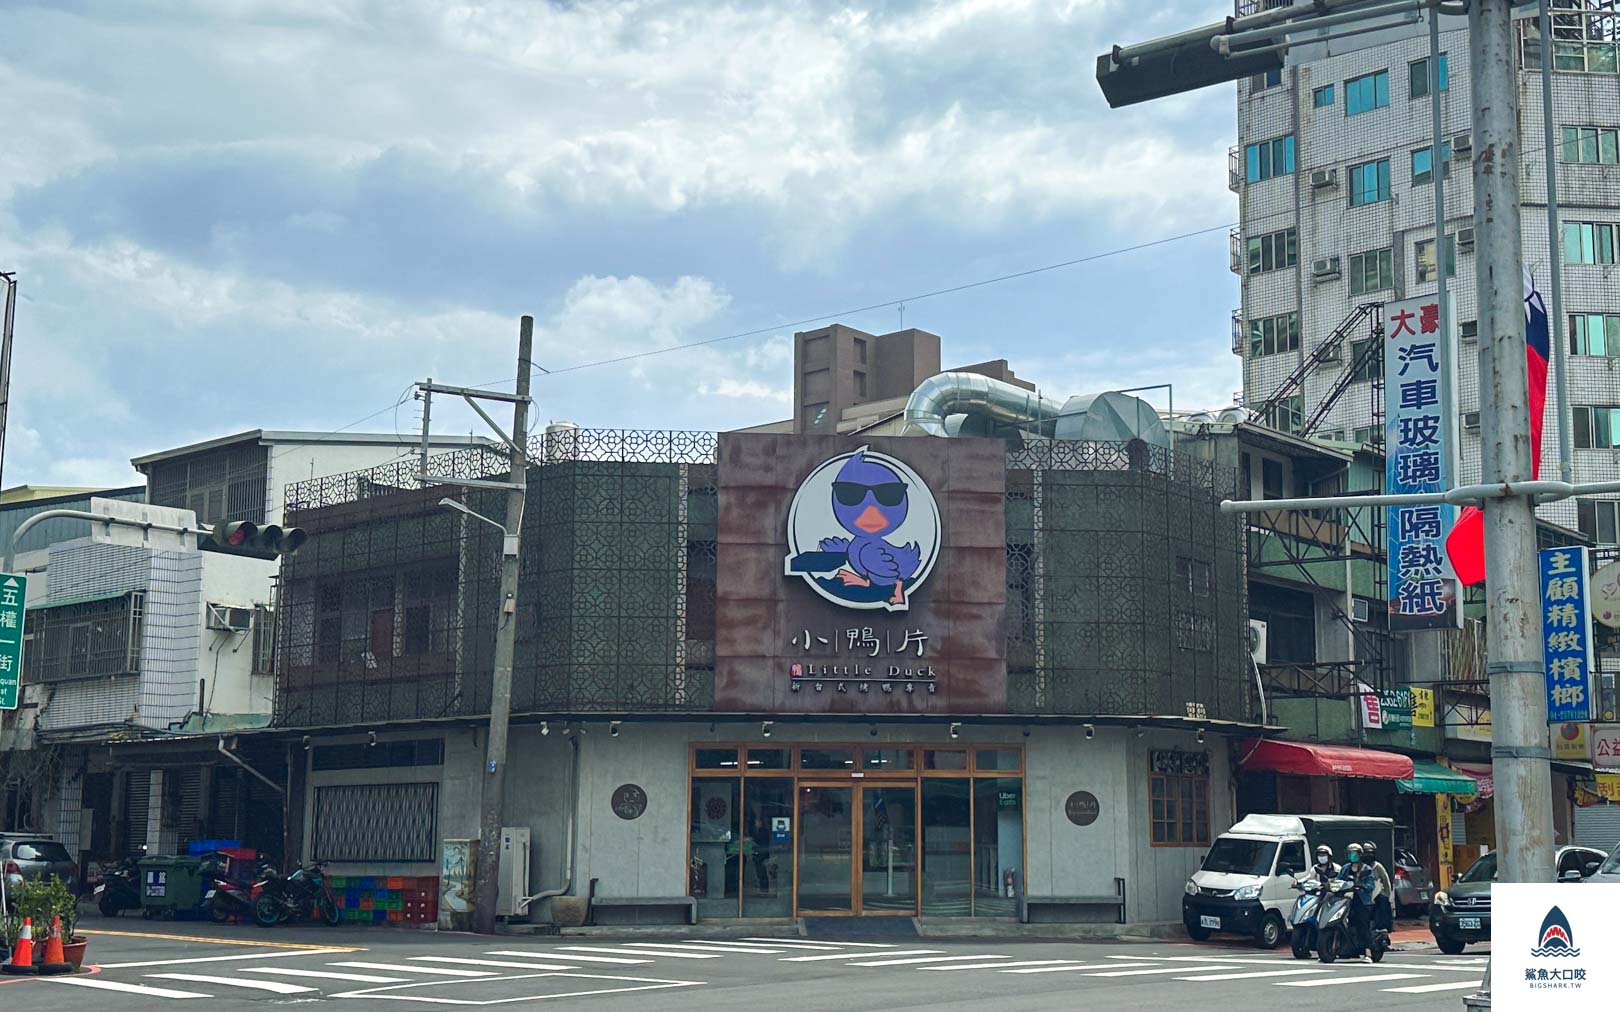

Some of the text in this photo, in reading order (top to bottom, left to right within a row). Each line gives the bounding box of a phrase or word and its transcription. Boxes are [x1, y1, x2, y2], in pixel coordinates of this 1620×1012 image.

[1390, 303, 1440, 339] 大豪
[1545, 551, 1584, 708] 主顧精緻檳榔
[808, 664, 872, 675] Little
[888, 665, 936, 677] Duck
